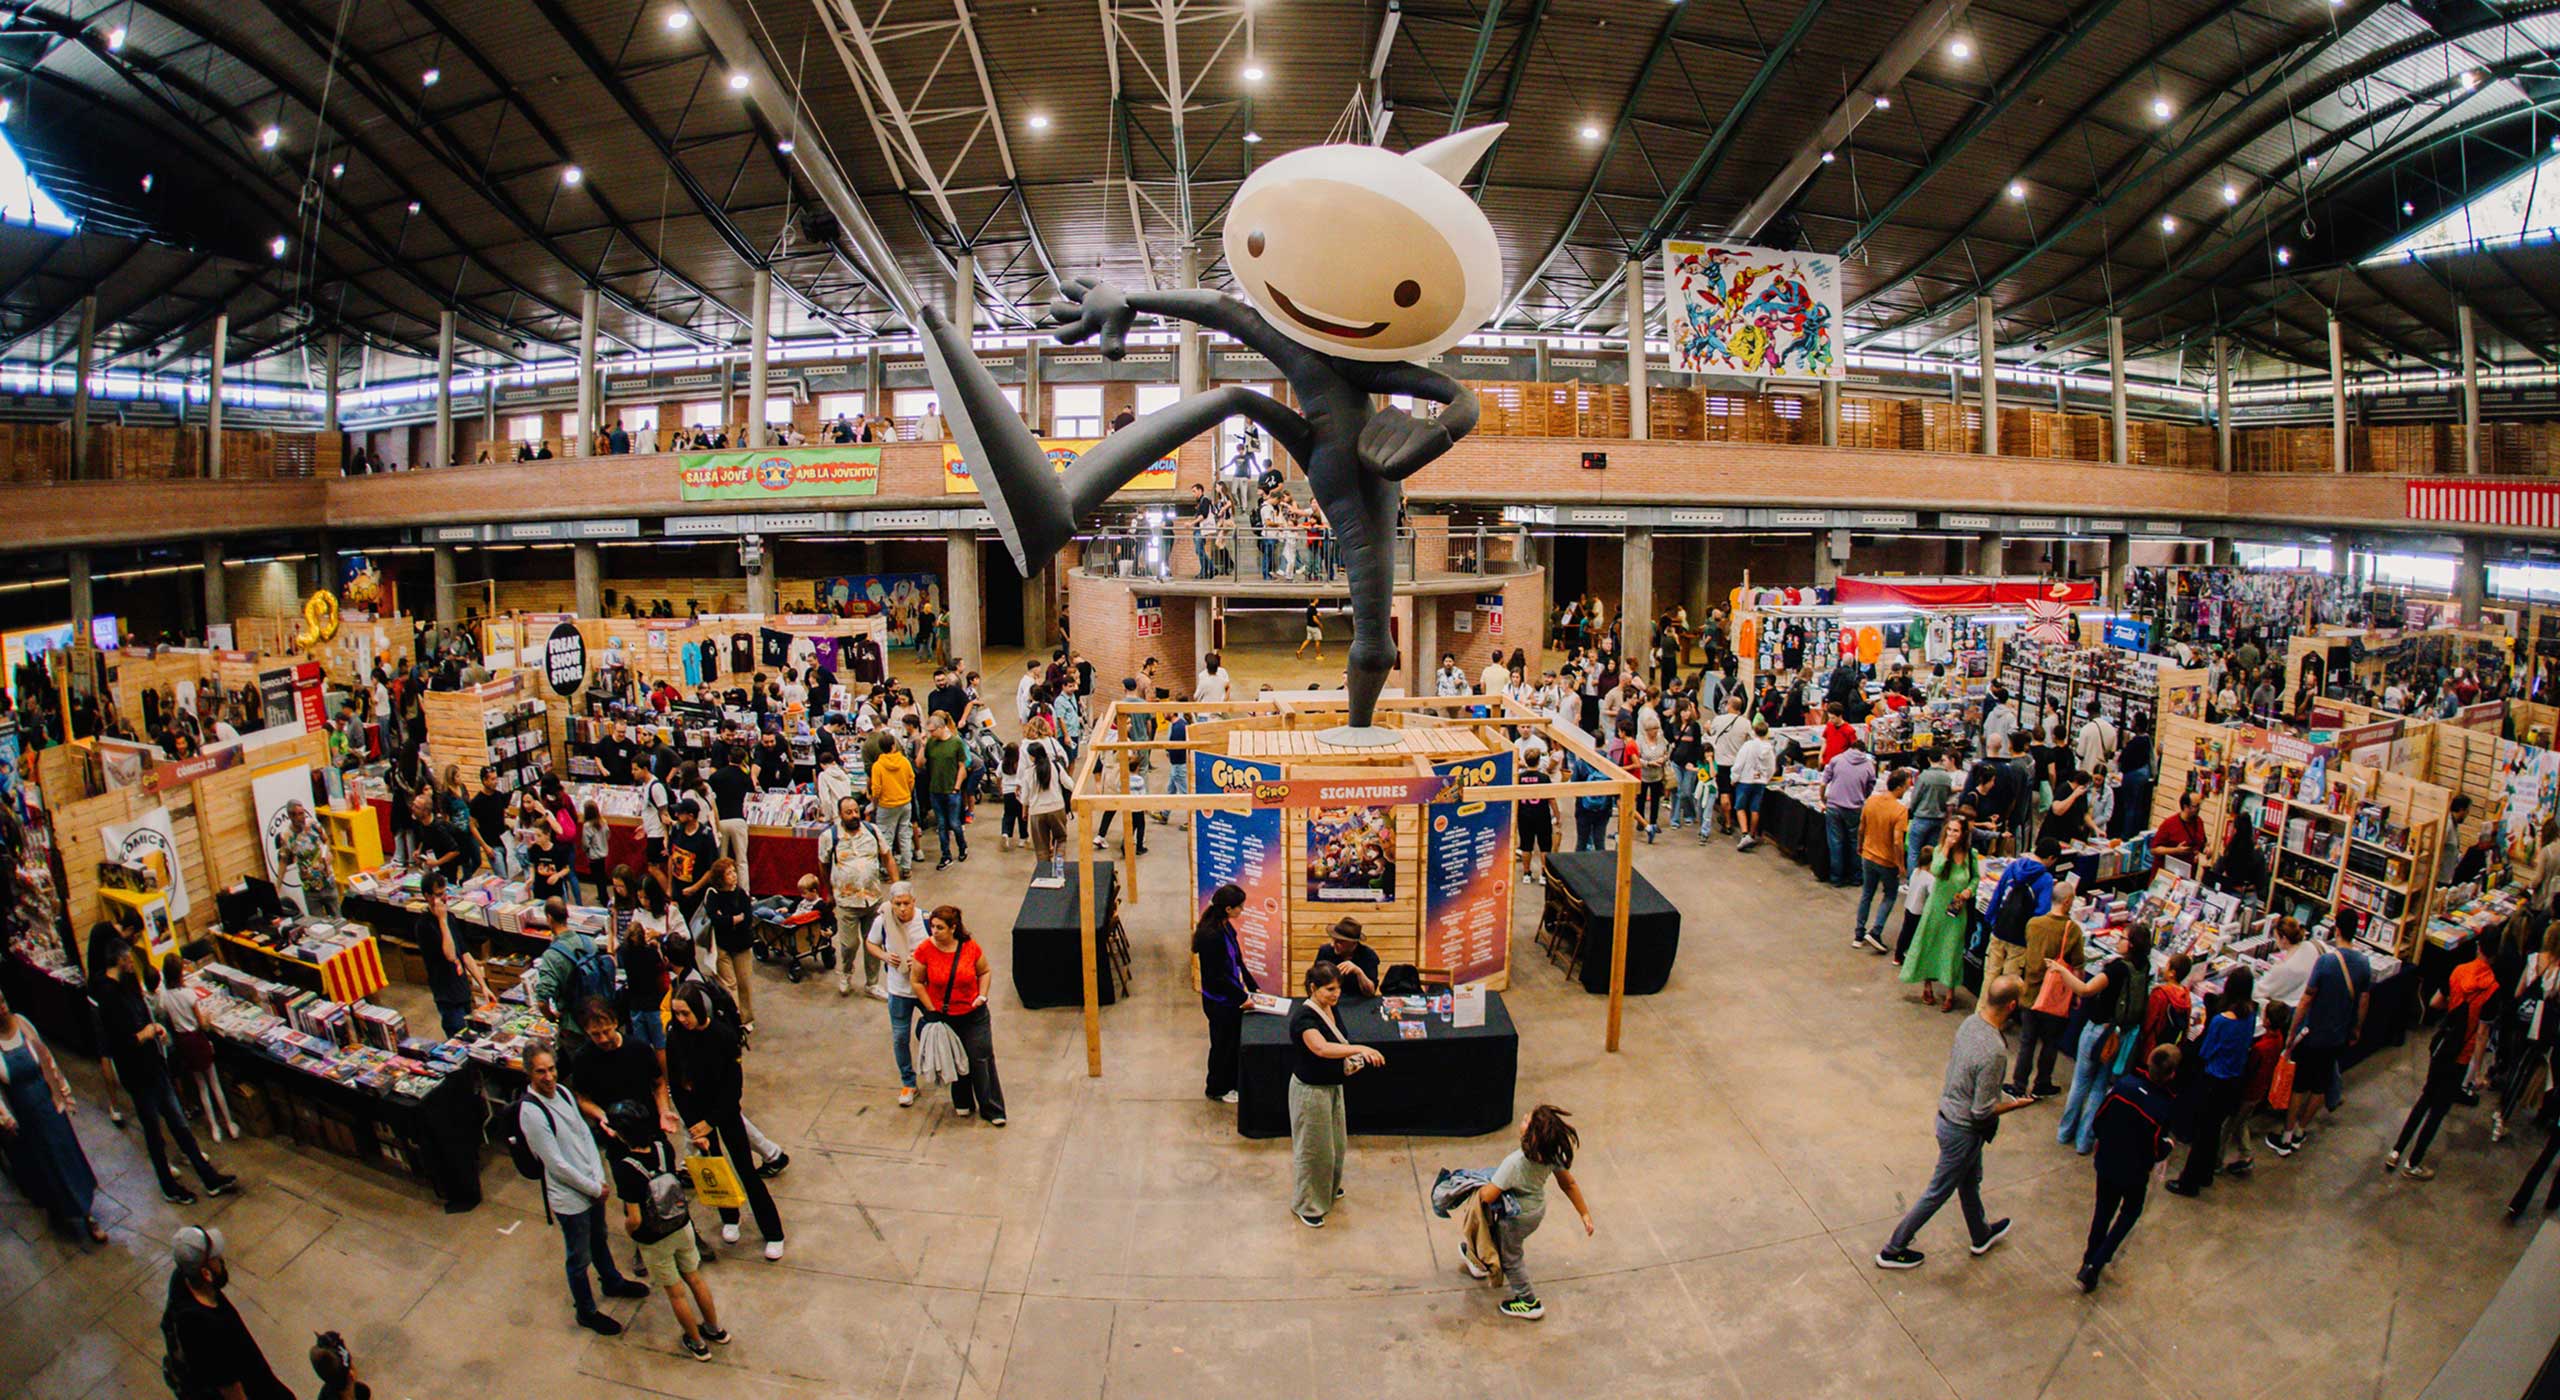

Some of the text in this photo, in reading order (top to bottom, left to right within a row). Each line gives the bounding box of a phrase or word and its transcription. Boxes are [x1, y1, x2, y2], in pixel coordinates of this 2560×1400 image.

[686, 471, 719, 484] SALSA
[720, 469, 748, 482] JOVE
[796, 467, 816, 479] AMB
[817, 467, 829, 479] LA
[830, 465, 878, 479] JOVENTUT
[549, 635, 581, 654] FREAK
[550, 650, 581, 670] SHOW
[551, 665, 583, 686] STORE
[1320, 785, 1408, 800] SIGNATURES
